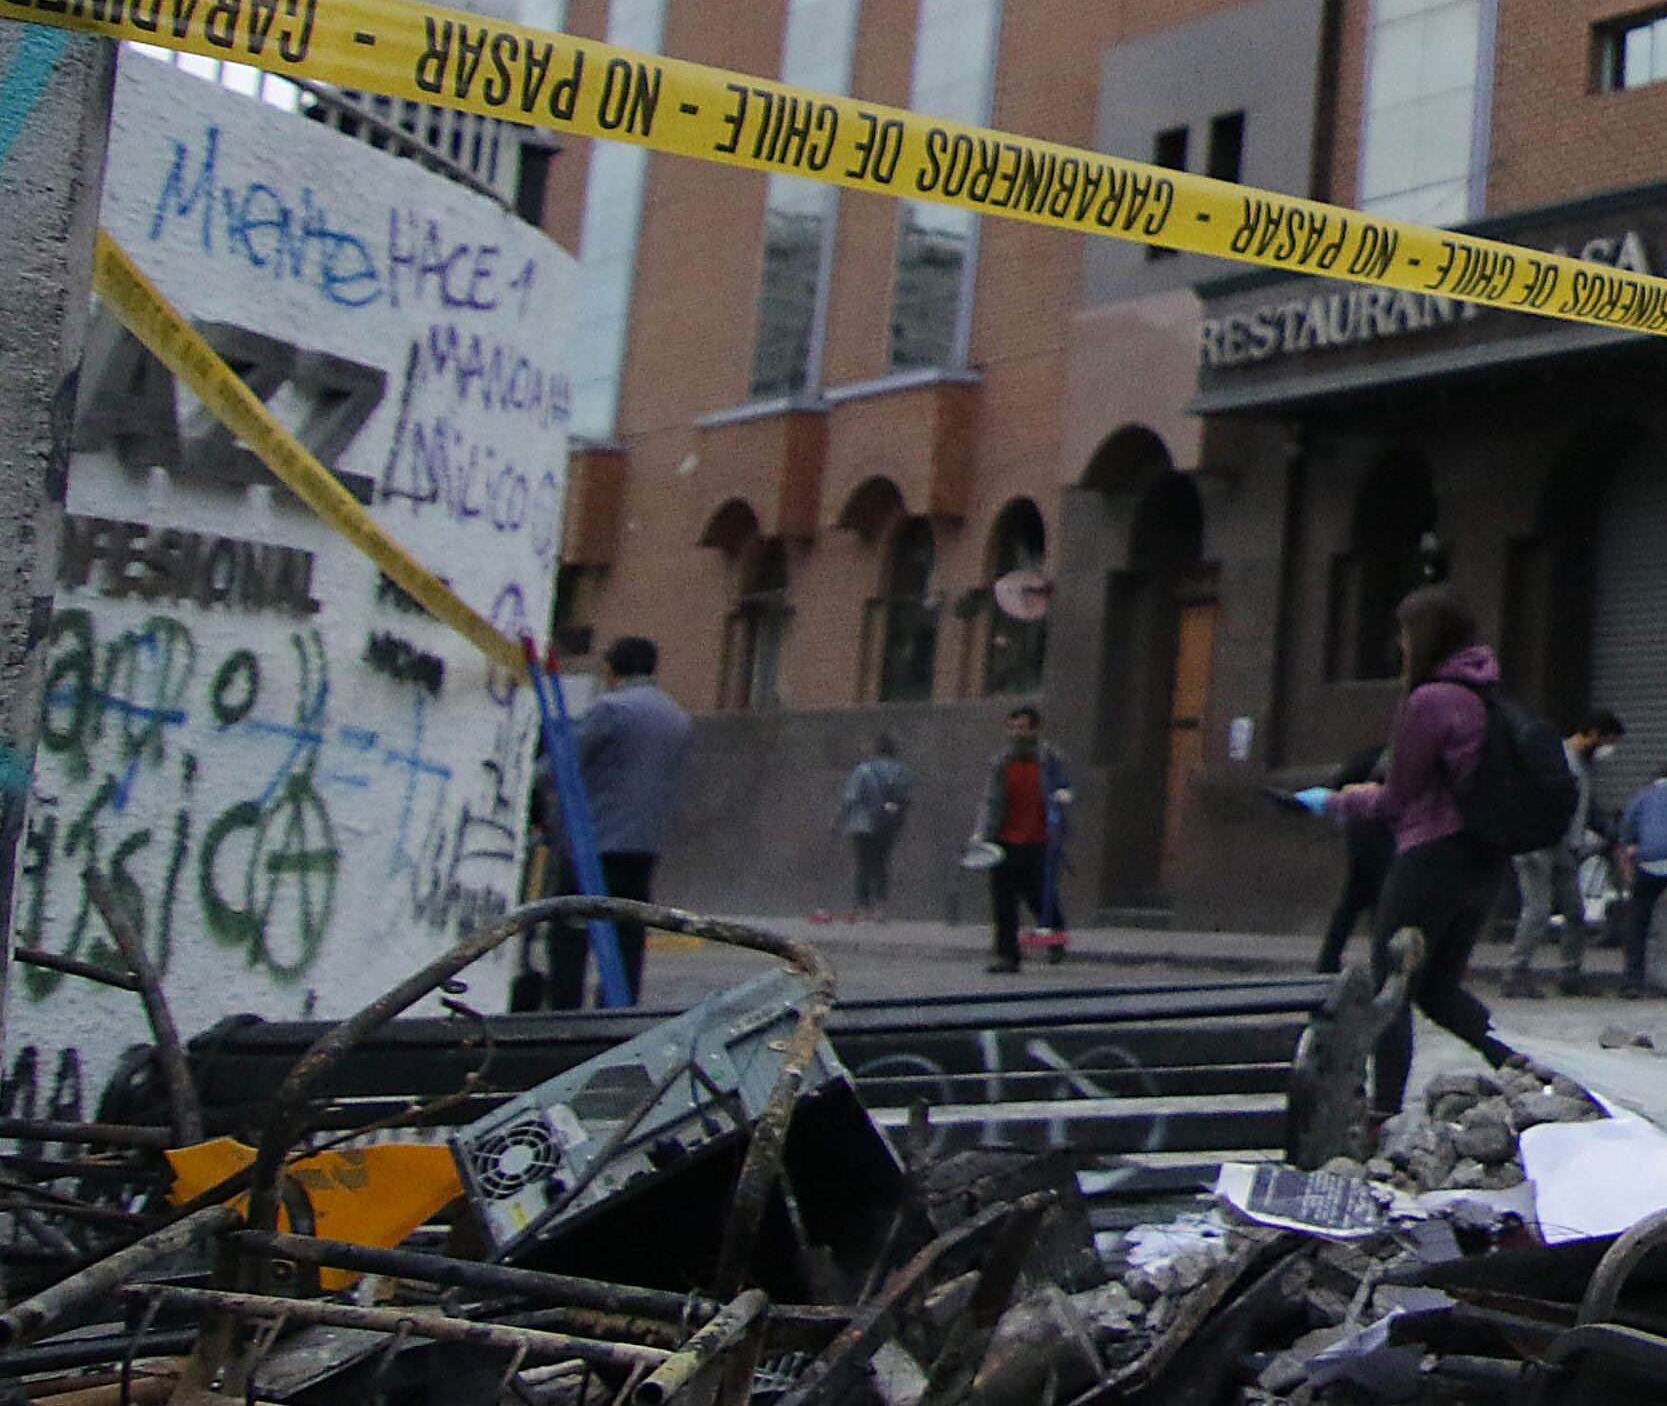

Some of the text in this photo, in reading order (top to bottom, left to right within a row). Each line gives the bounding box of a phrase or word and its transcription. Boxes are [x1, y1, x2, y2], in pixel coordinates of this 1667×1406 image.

[414, 15, 586, 122] PASAR
[596, 56, 662, 137] NO
[714, 83, 839, 172] CHILE
[844, 111, 905, 185] DE
[915, 127, 1175, 236] CARABINEROS
[1229, 197, 1349, 270] PASAR
[1347, 223, 1400, 280] NO
[1424, 240, 1516, 302] CHILE
[1513, 258, 1560, 308] DE
